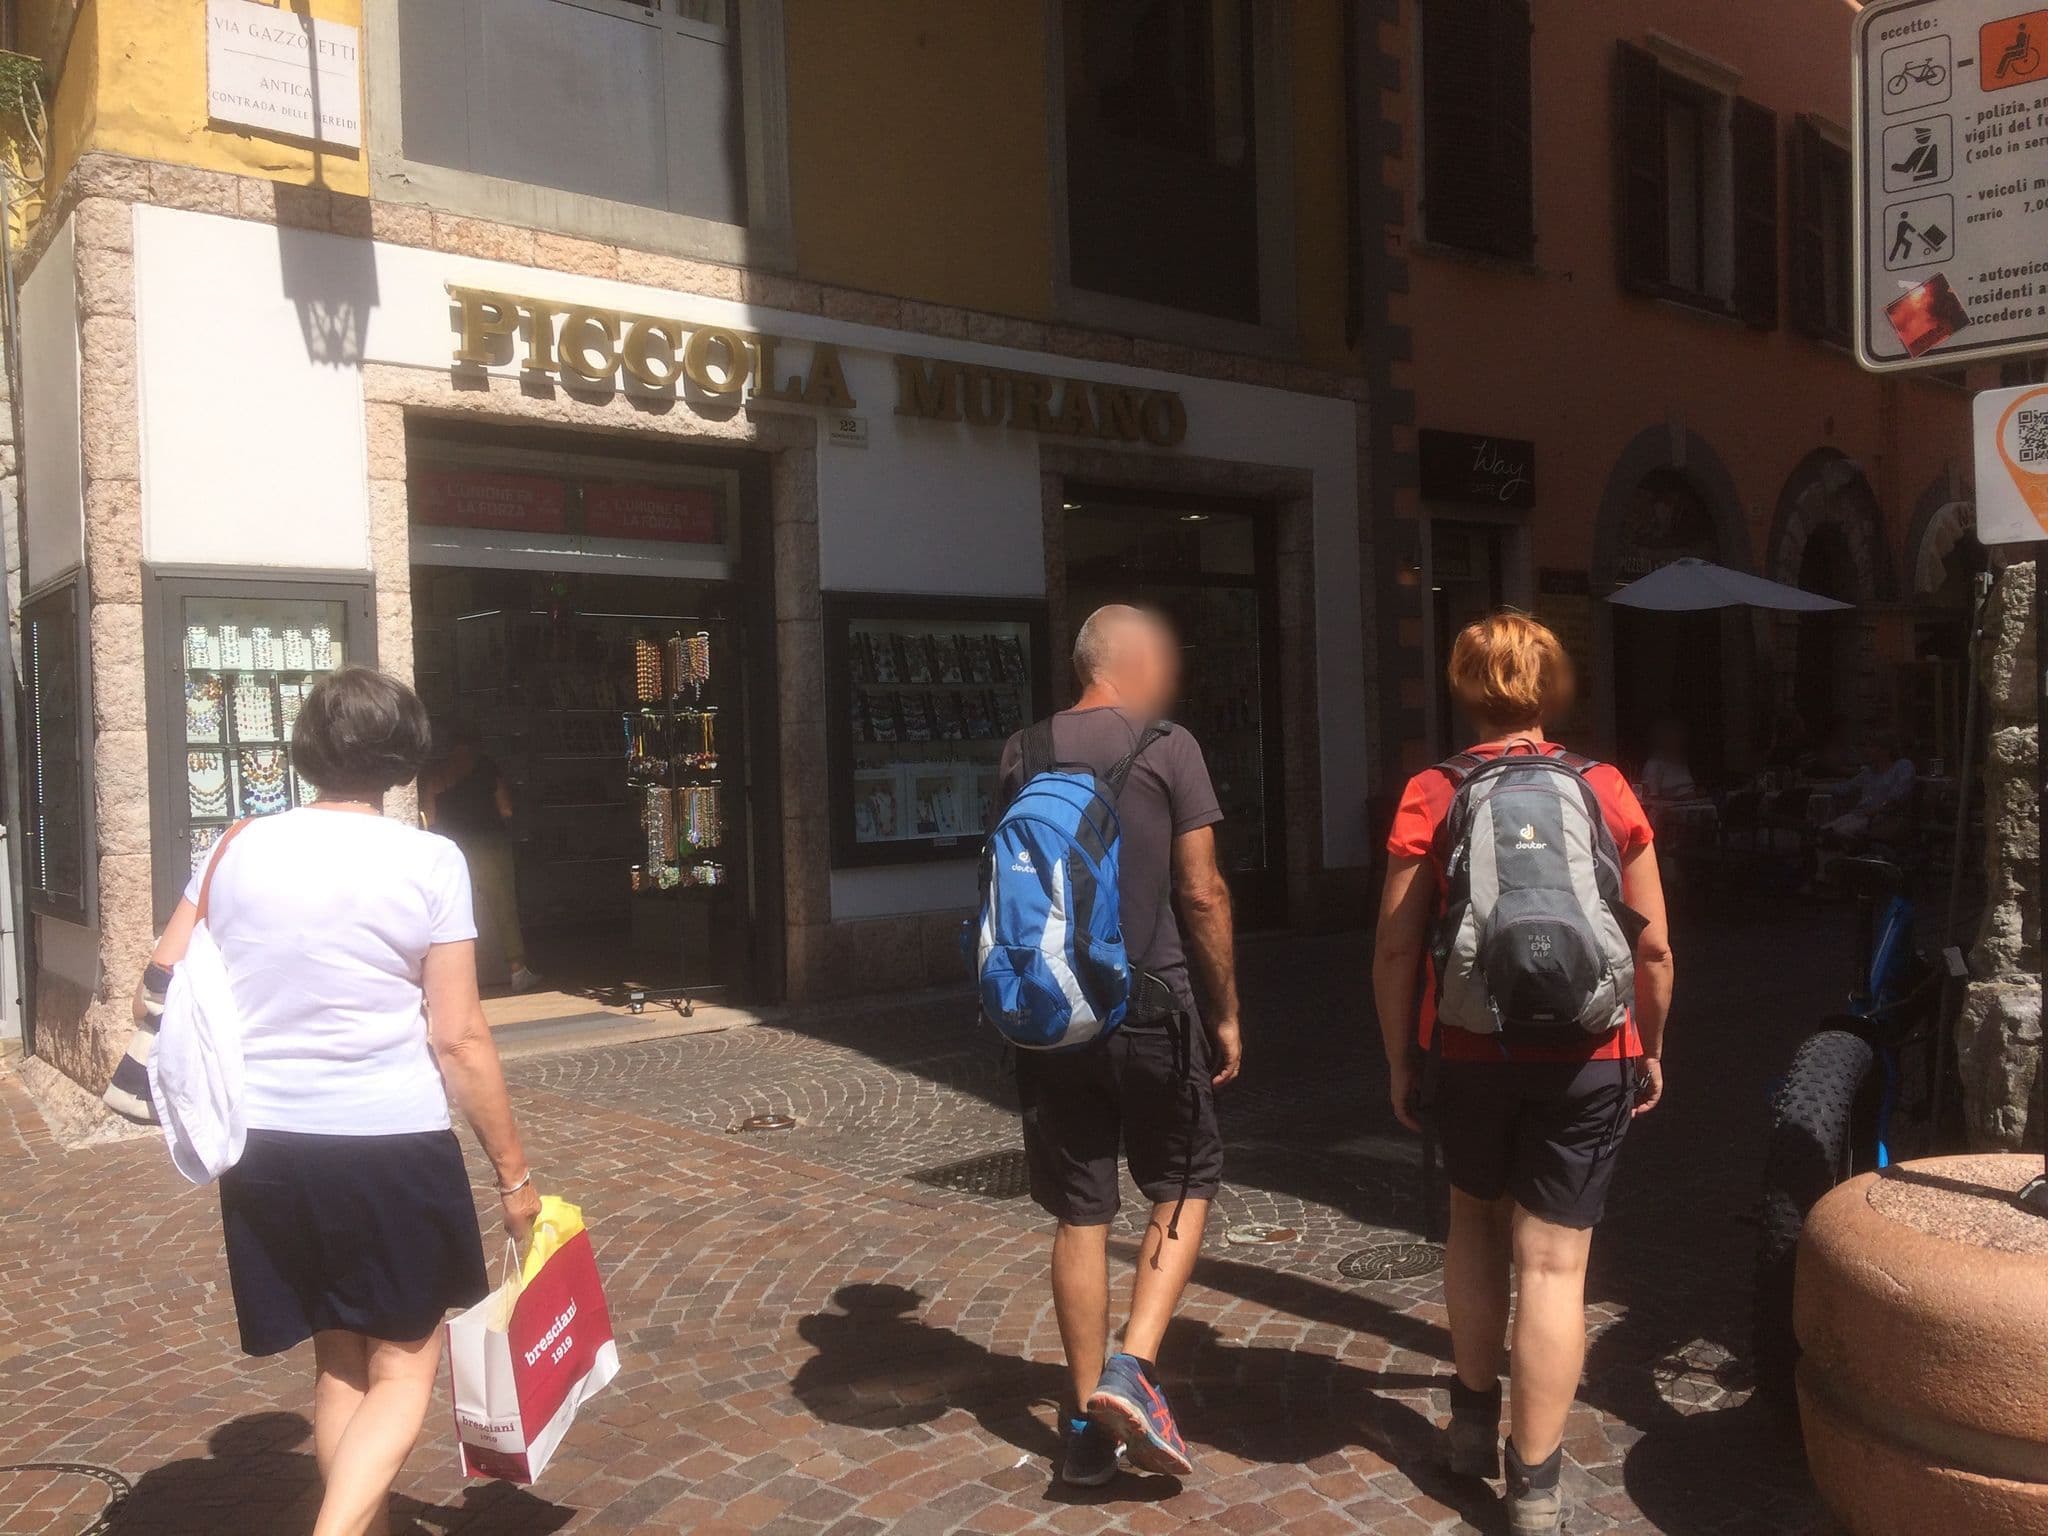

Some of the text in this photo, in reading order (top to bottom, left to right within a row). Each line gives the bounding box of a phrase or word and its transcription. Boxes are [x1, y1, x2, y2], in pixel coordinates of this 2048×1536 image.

[214, 16, 240, 34] VIA
[1880, 18, 1939, 41] eccetto:
[260, 77, 313, 100] ANTICA
[212, 91, 276, 112] CONTRADA
[1965, 123, 2003, 144] vigili
[2008, 117, 2032, 134] del
[2007, 141, 2020, 152] in
[2025, 136, 2048, 150] ser
[1978, 178, 2048, 201] veicoli m
[1966, 208, 2003, 223] orario
[1968, 282, 2033, 306] residenti
[447, 284, 1187, 447] PICCOLA MURANO
[839, 419, 857, 433] 22
[1471, 439, 1531, 504] Way
[1515, 841, 1547, 850] deuter
[524, 1296, 577, 1367] bresciani
[551, 1335, 573, 1365] 1919
[462, 1415, 516, 1433] bresciani
